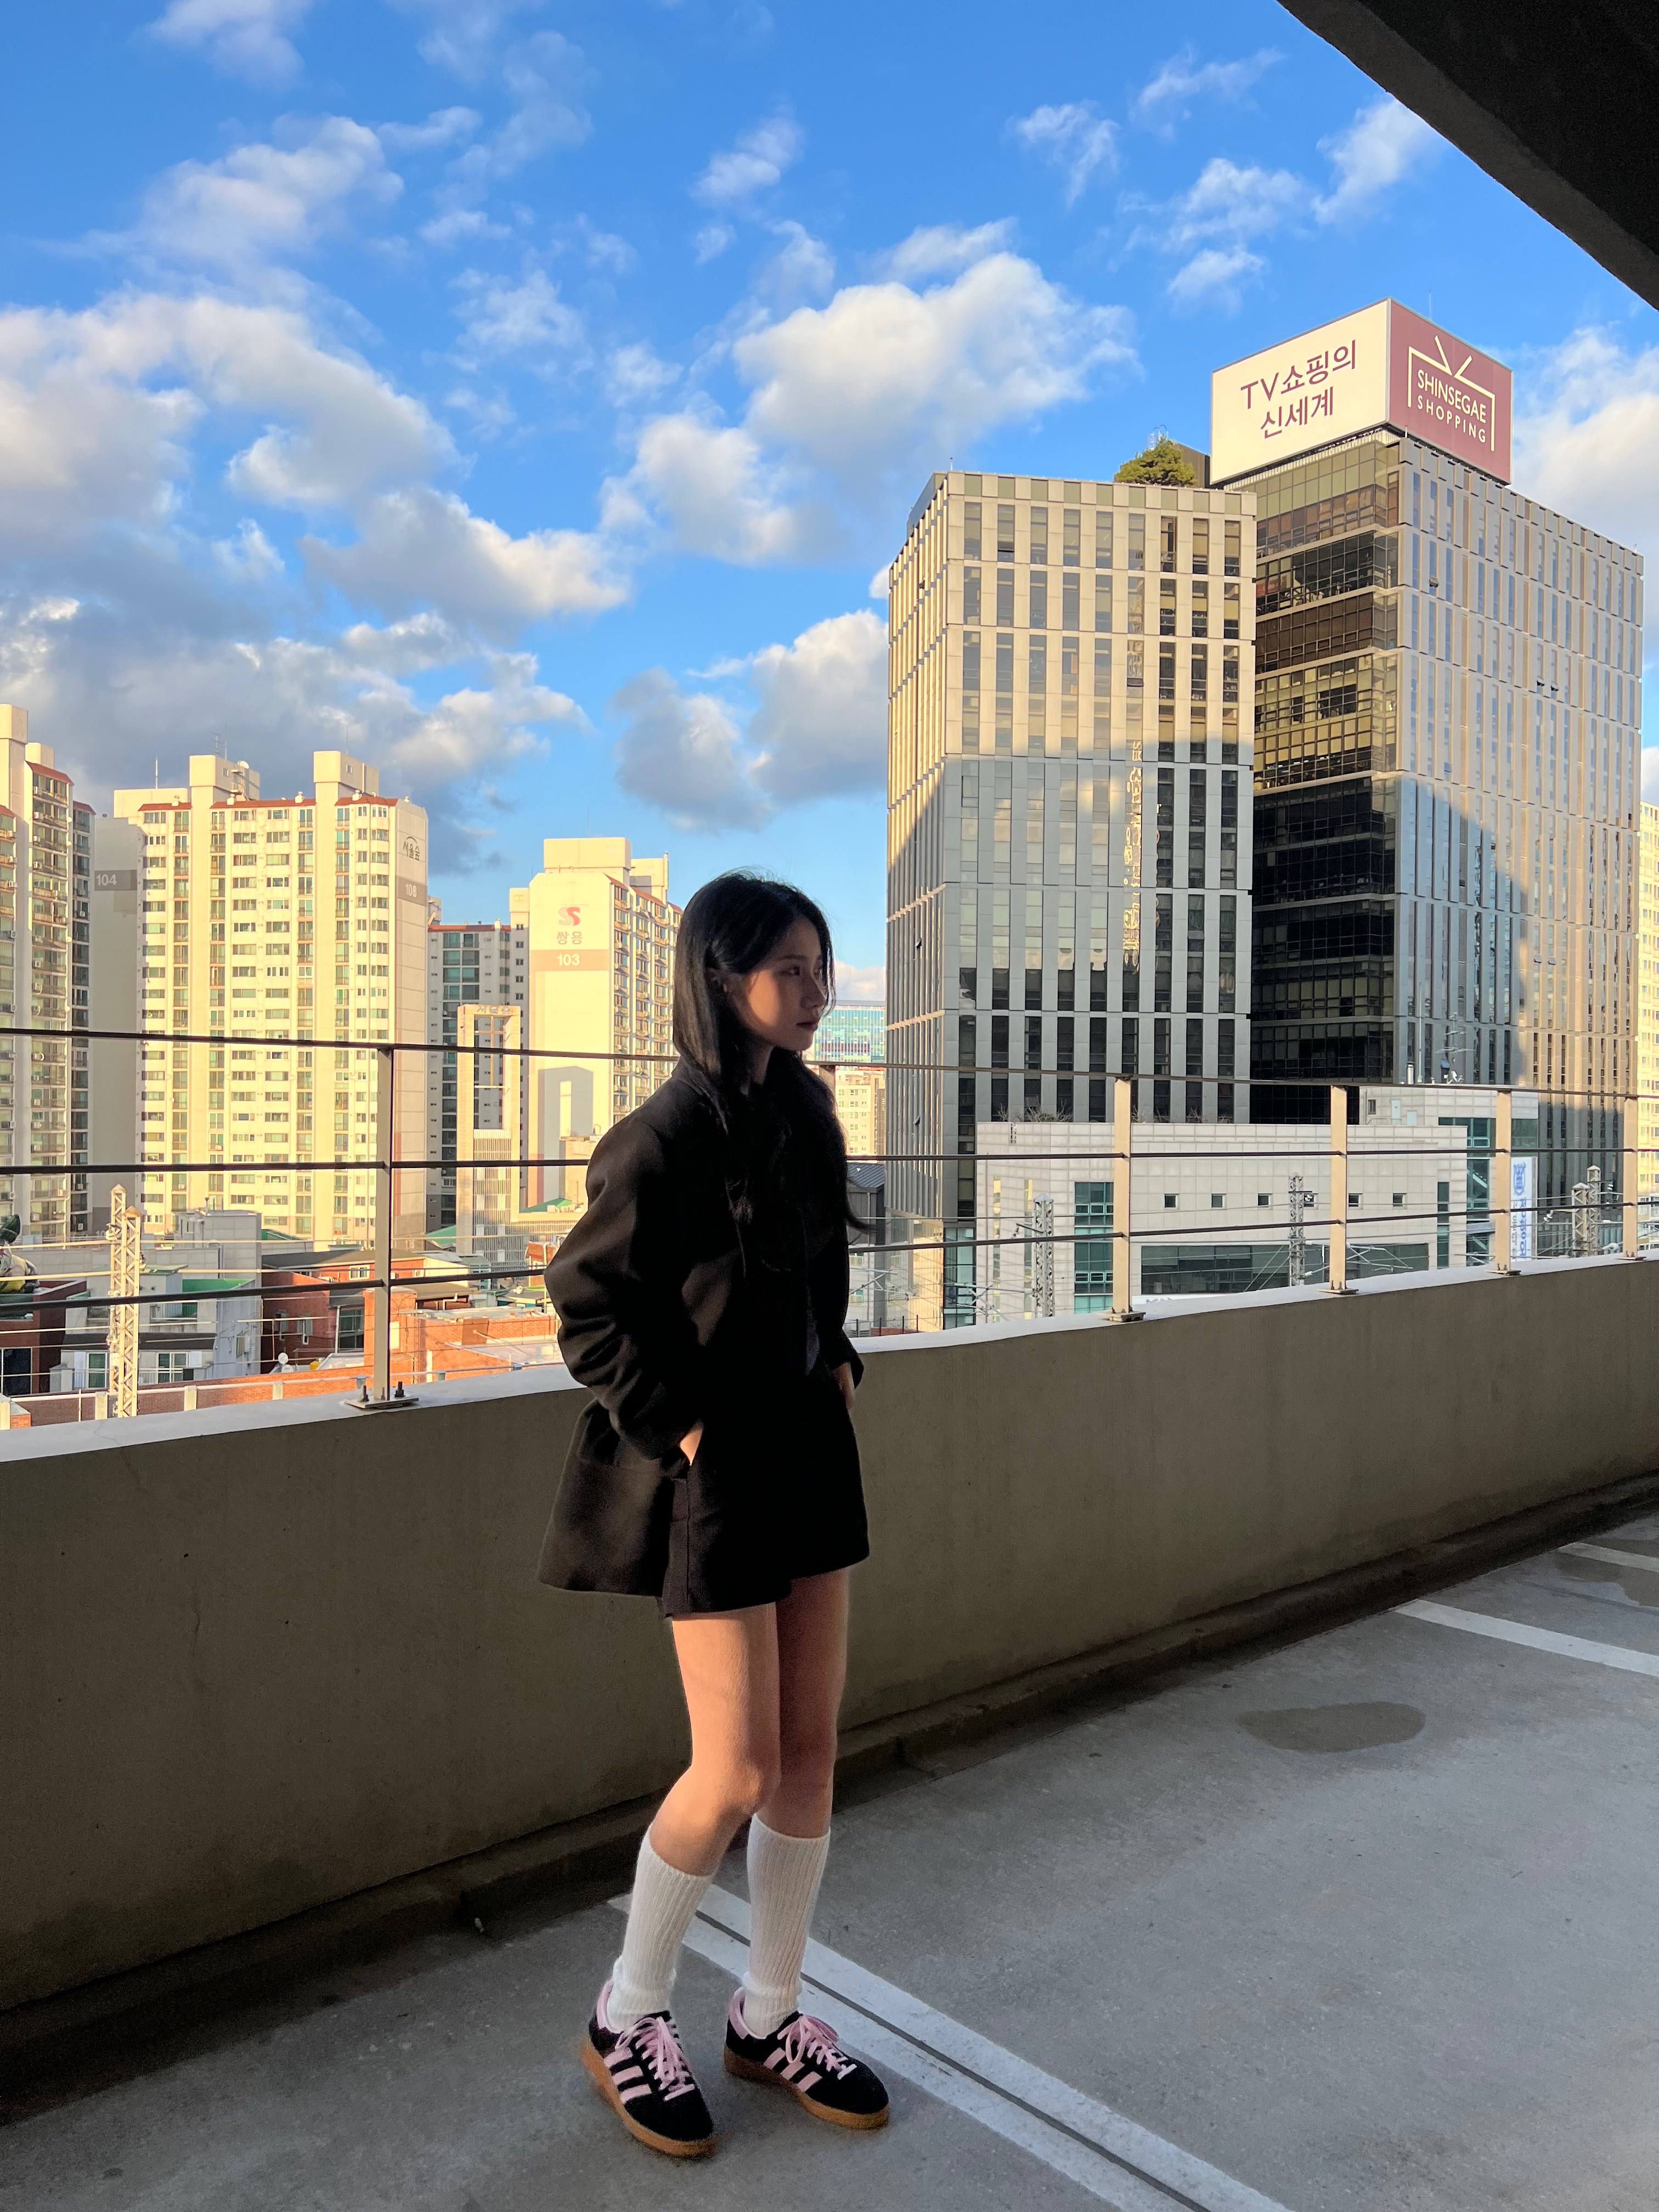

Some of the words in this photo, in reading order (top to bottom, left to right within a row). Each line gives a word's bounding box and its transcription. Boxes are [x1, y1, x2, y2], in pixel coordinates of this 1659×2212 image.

[1240, 339, 1356, 409] TV쇼핑의
[1418, 369, 1486, 424] SHINSEGAE
[1260, 386, 1334, 439] 신세계
[1418, 395, 1486, 443] SHOPPING
[403, 840, 420, 861] 서울숲
[96, 873, 117, 886] 104
[405, 883, 417, 898] 108
[556, 931, 583, 944] 쌍용
[557, 953, 580, 966] 103
